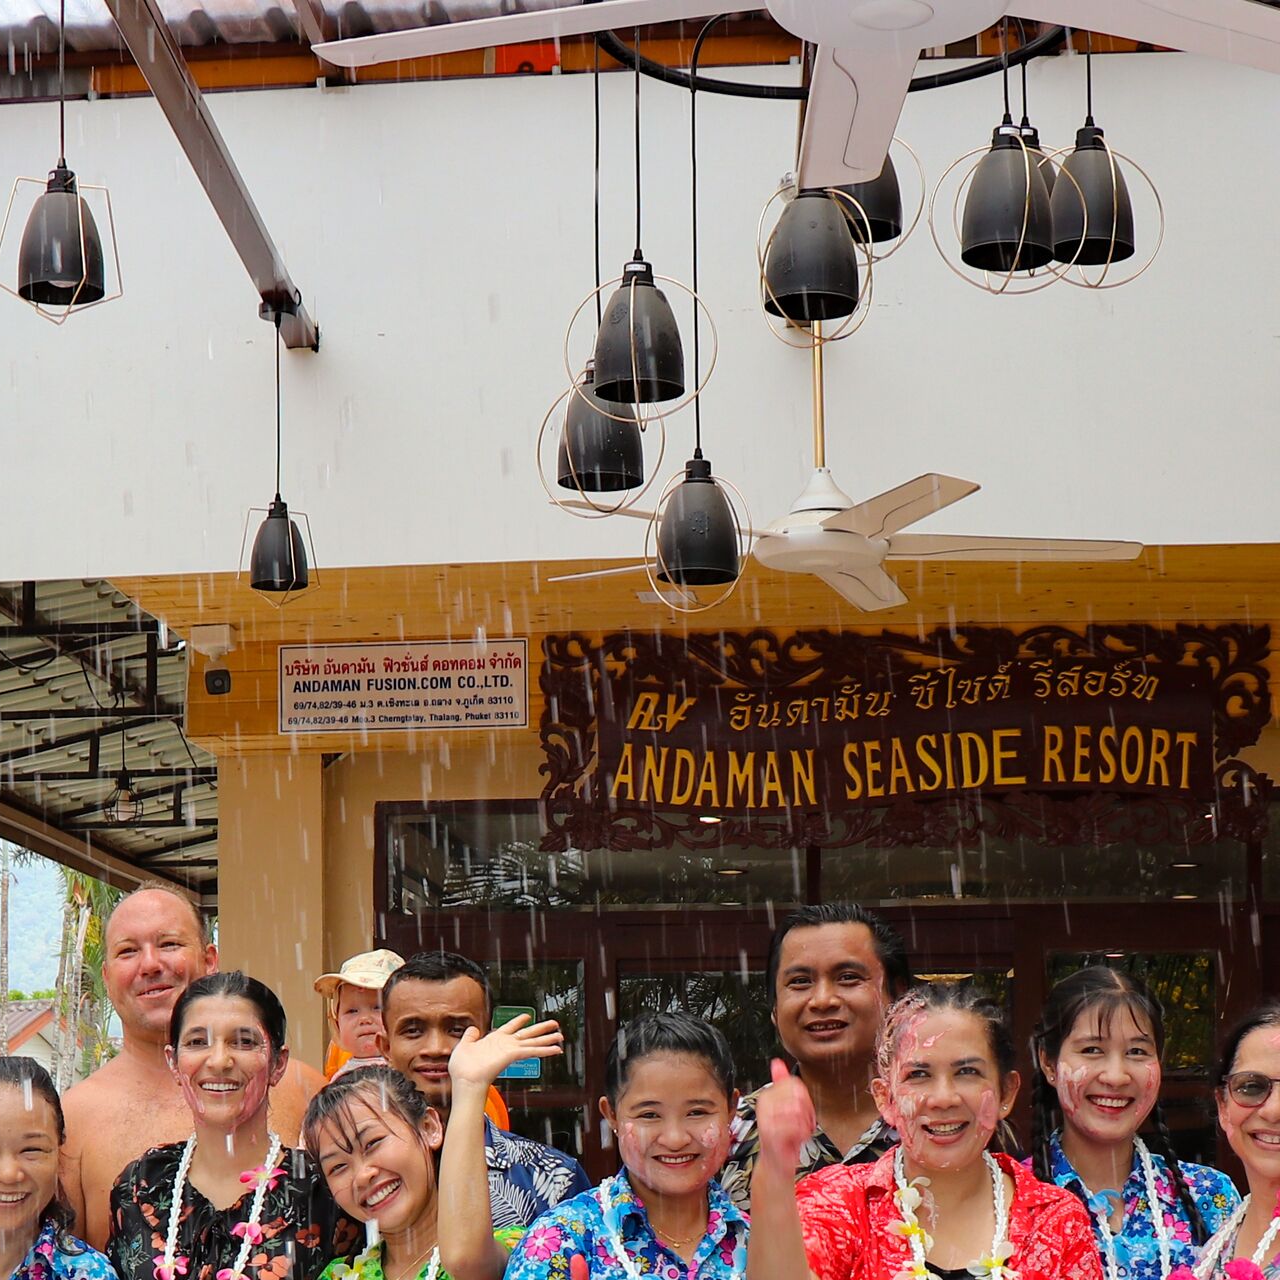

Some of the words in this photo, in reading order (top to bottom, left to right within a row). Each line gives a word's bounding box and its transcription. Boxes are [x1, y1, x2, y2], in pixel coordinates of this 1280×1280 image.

[285, 658, 320, 676] บริษัท
[324, 657, 375, 675] อันดามัน
[433, 658, 485, 671] ดอทคอม
[489, 652, 522, 670] จำกัด
[293, 679, 360, 693] ANDAMAN
[367, 676, 452, 691] FUSION.COM
[458, 675, 513, 690] CO.,LTD.
[729, 683, 892, 731] อันดามัน
[1029, 658, 1159, 701] รีสอร์ท
[487, 696, 514, 705] 83110
[465, 712, 491, 720] Phuket
[494, 711, 520, 720] 83110
[608, 743, 818, 808] ANDAMAN
[843, 729, 1027, 800] SEASIDE
[1042, 725, 1198, 789] RESORT
